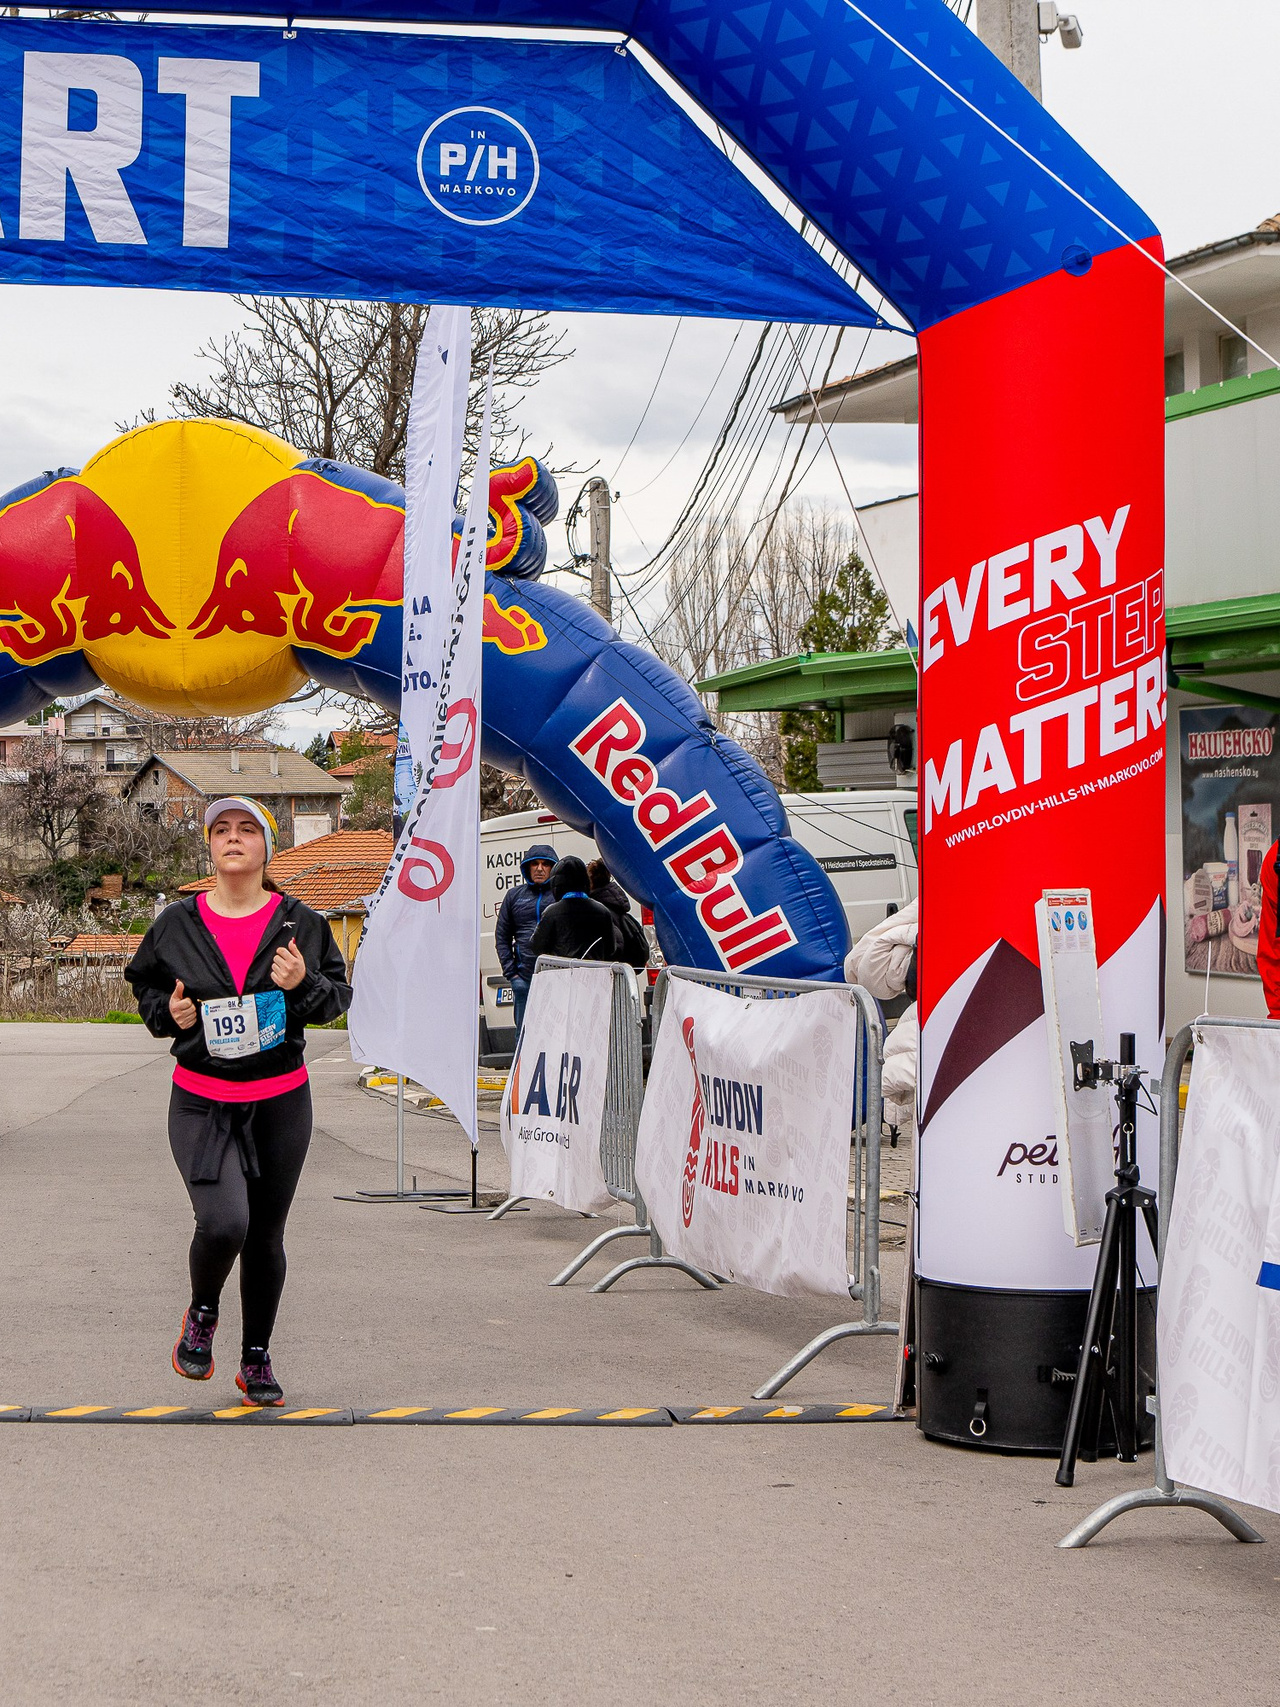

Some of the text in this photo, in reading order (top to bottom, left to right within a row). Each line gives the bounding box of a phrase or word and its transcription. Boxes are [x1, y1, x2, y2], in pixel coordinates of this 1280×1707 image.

[470, 130, 485, 140] IN
[439, 142, 517, 181] P/H
[439, 183, 517, 197] MARKOVO
[923, 504, 1131, 673] EVERY
[1016, 569, 1164, 701] STEP
[1188, 728, 1273, 760] НАШЕНСКО
[1202, 766, 1259, 779] www.nashensko.bg
[945, 748, 1164, 848] WWW.PLOVDIV-HILLS-IN-MARKOVO.COM
[574, 703, 791, 968] Red Bull
[487, 852, 526, 869] KACH
[212, 1014, 246, 1037] 193
[701, 1073, 763, 1135] PLOVDIV
[744, 1155, 755, 1171] IN
[745, 1178, 804, 1203] MARKOVO
[1016, 1174, 1058, 1183] STUD
